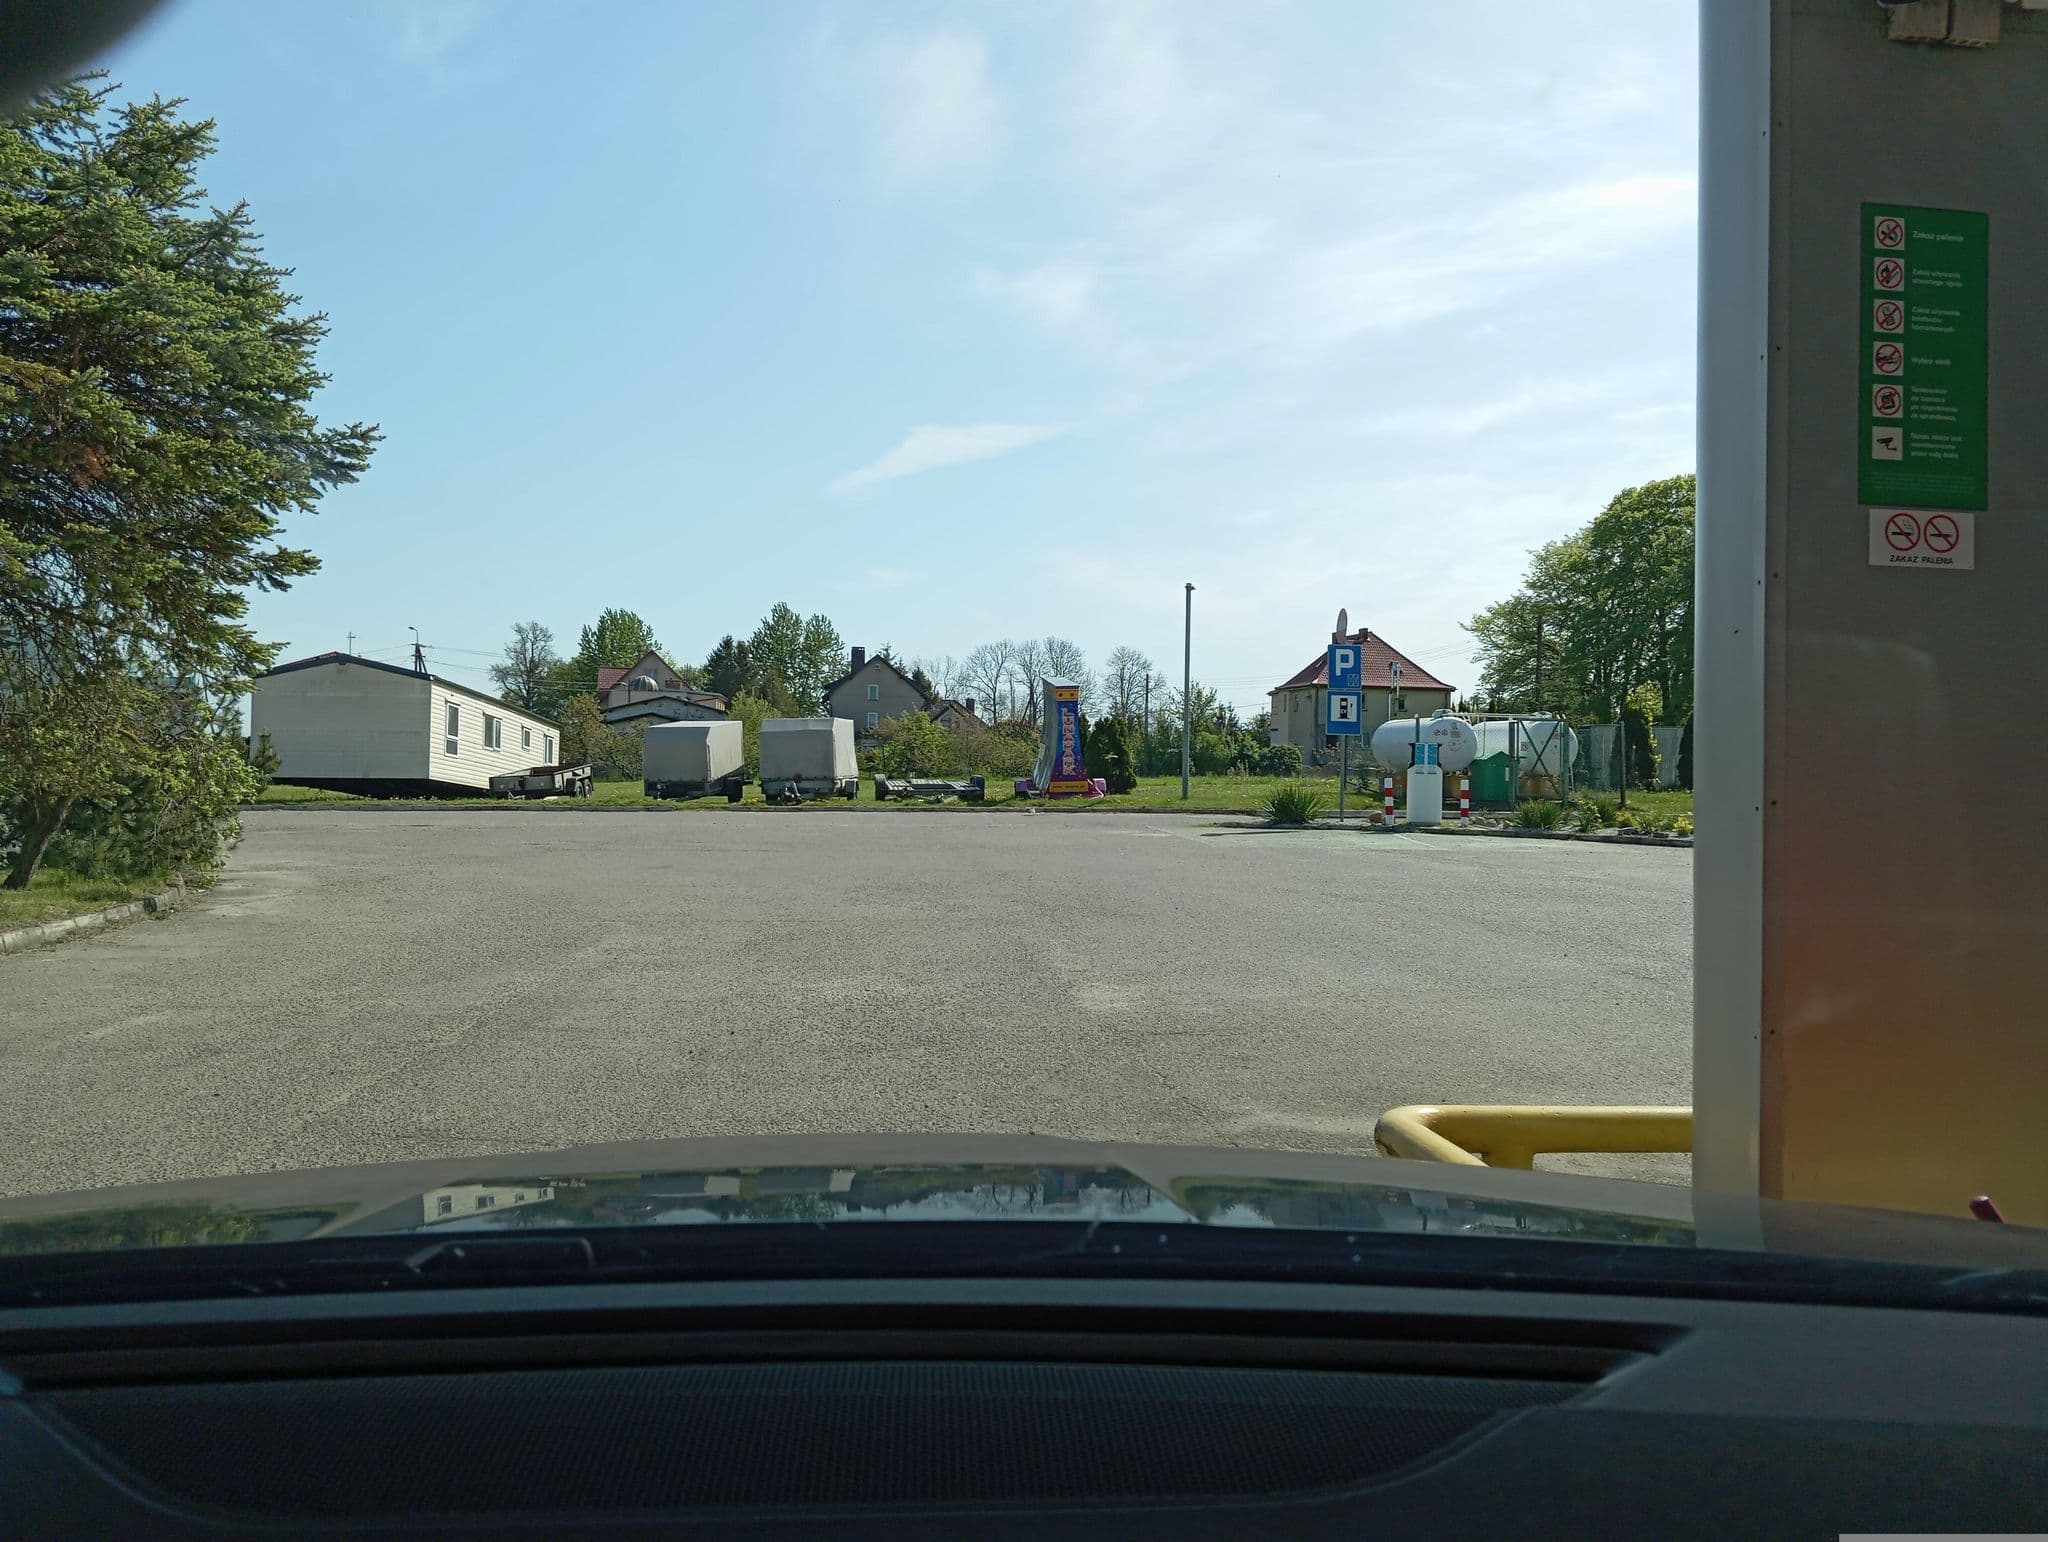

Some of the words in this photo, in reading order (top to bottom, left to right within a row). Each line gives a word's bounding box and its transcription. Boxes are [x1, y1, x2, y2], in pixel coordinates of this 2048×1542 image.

[1889, 554, 1919, 563] ZAKAZ
[1921, 556, 1954, 565] PALENIA
[1335, 649, 1354, 676] P
[1062, 707, 1076, 775] LUNAPARK
